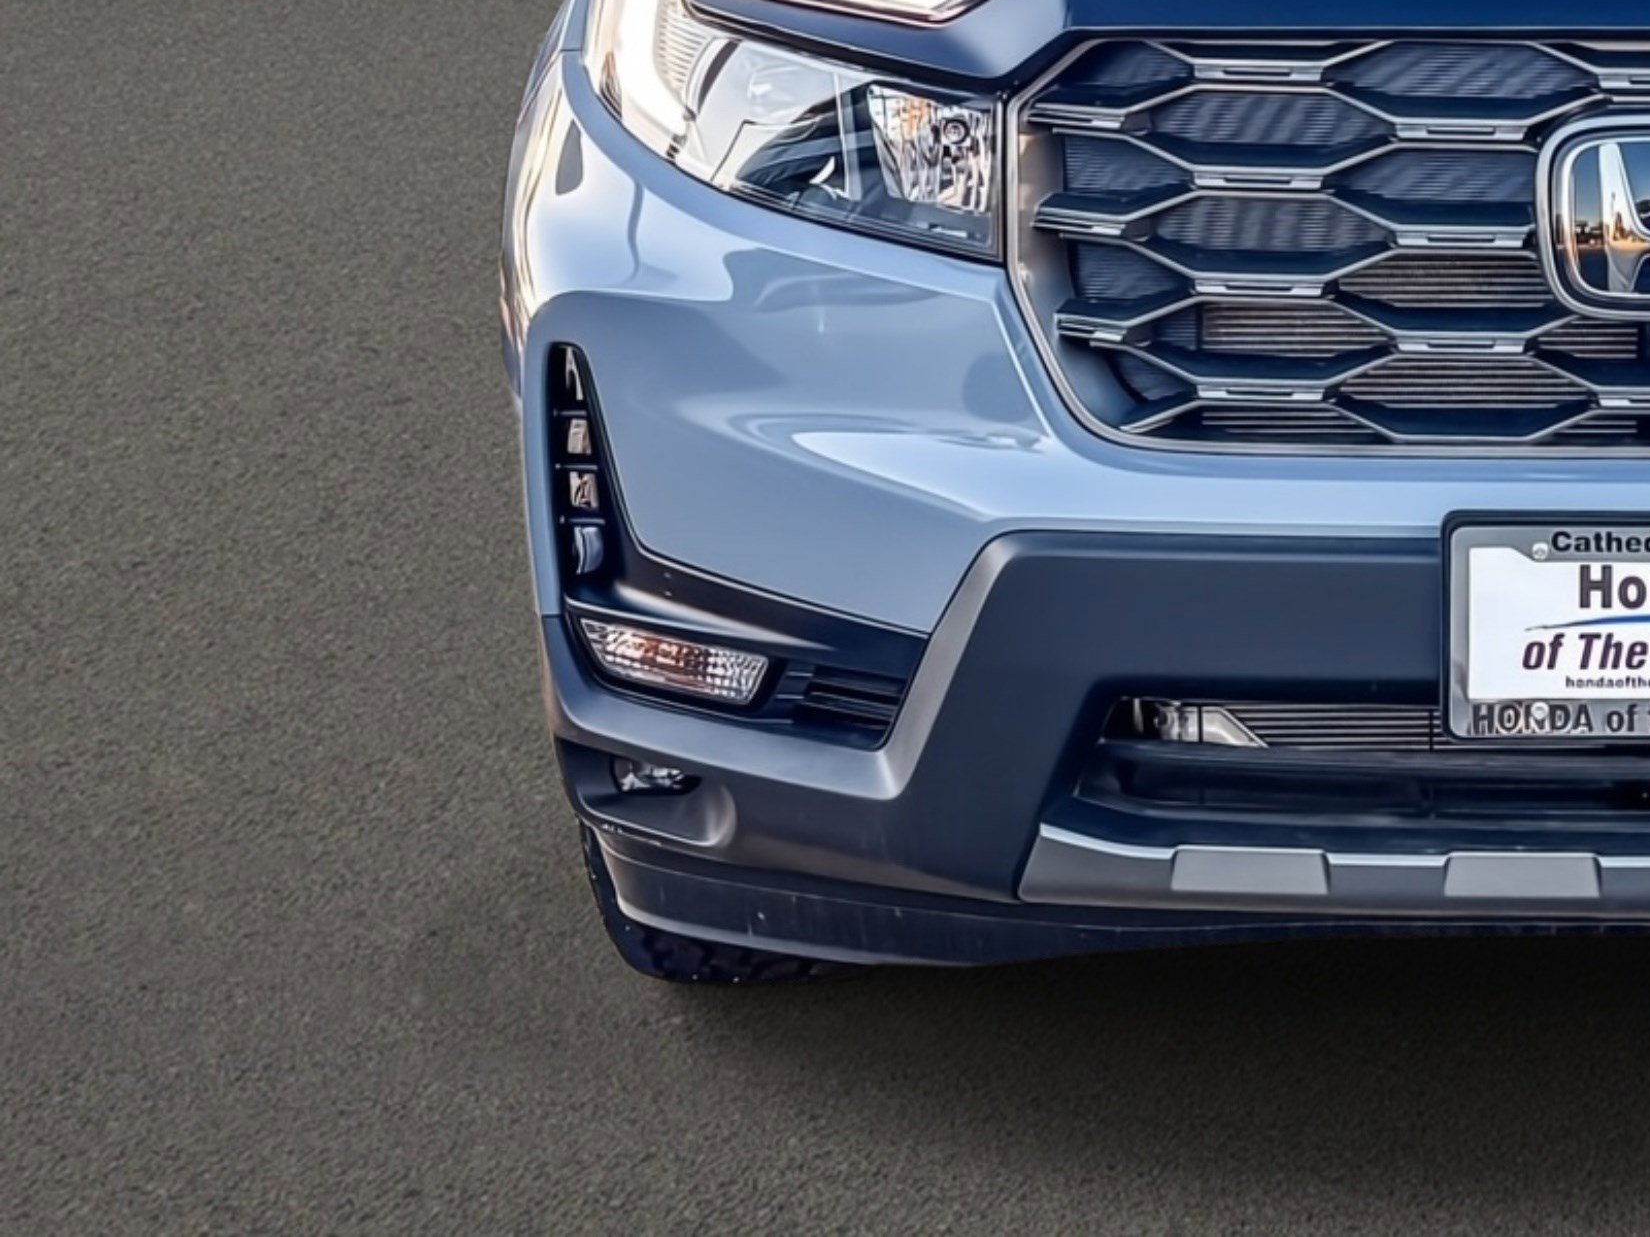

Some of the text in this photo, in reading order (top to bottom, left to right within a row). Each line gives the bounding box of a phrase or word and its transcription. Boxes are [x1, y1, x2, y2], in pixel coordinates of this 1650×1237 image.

[1522, 633, 1563, 671] of
[1577, 633, 1649, 670] The
[1606, 703, 1638, 733] of
